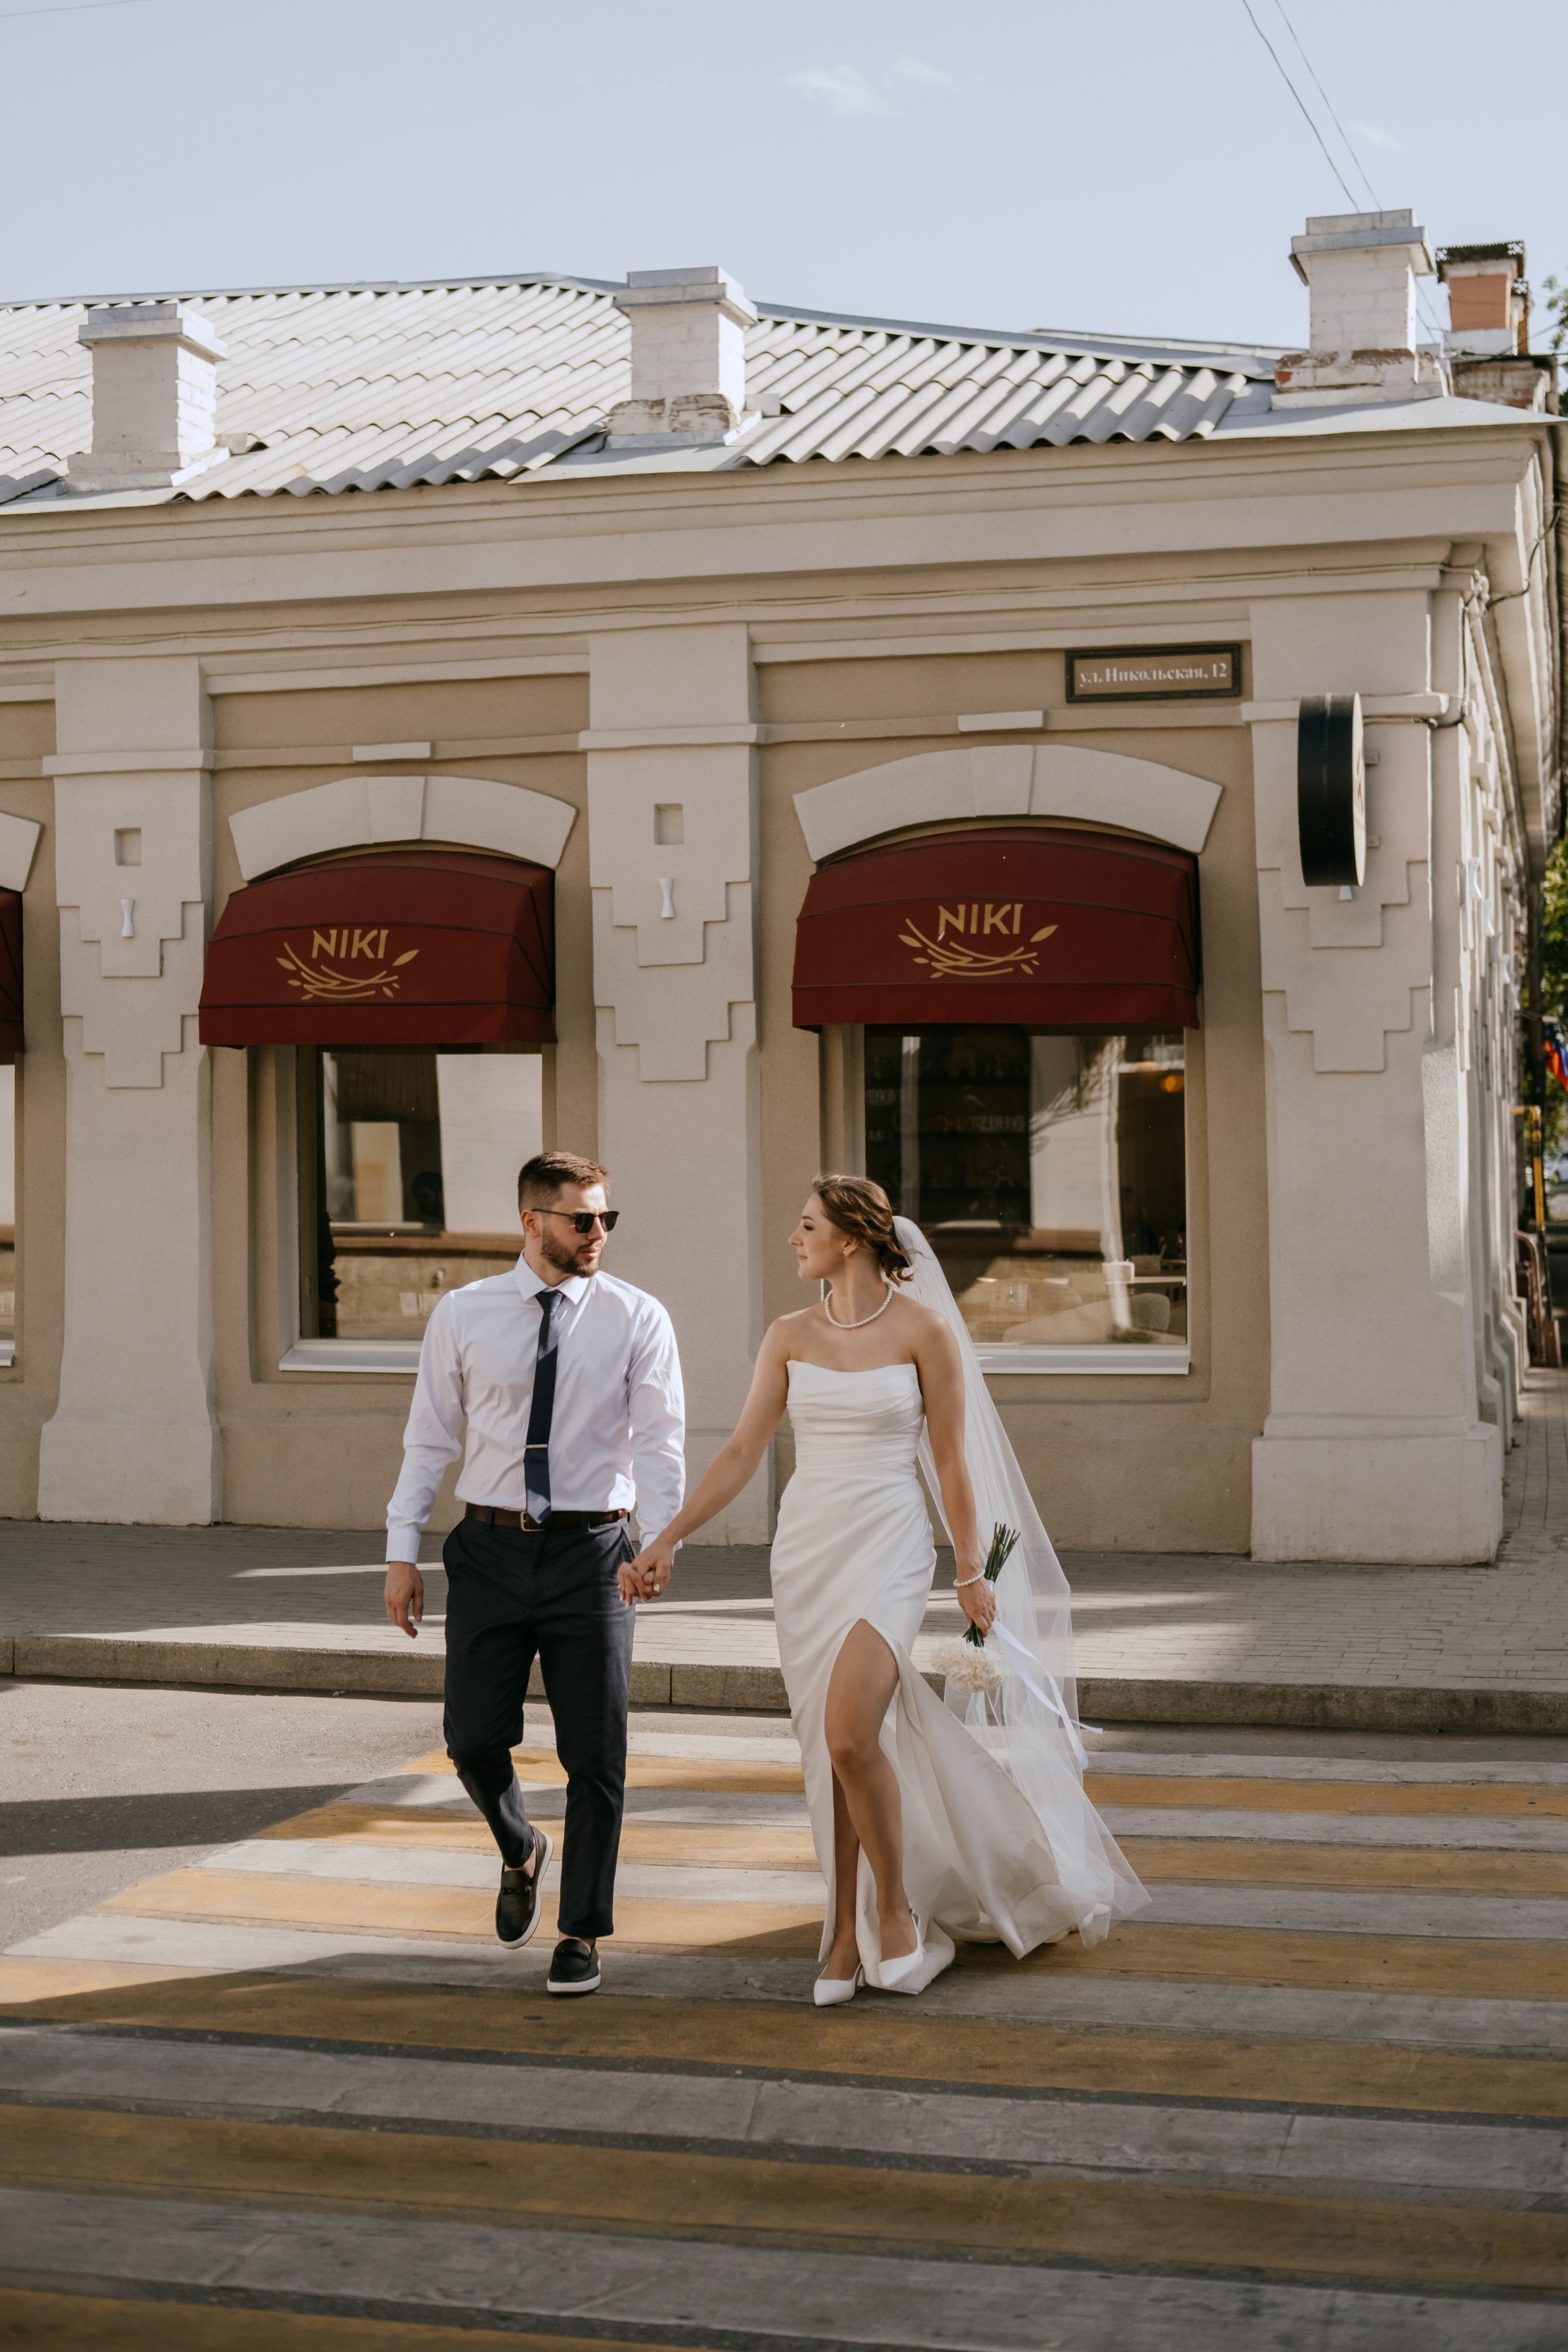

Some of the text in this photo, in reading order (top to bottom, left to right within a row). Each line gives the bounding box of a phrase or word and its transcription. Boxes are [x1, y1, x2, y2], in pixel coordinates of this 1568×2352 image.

[1080, 663, 1227, 688] ул. Никольская, 12
[938, 903, 1023, 935] NIKI
[312, 929, 389, 959] NIKI
